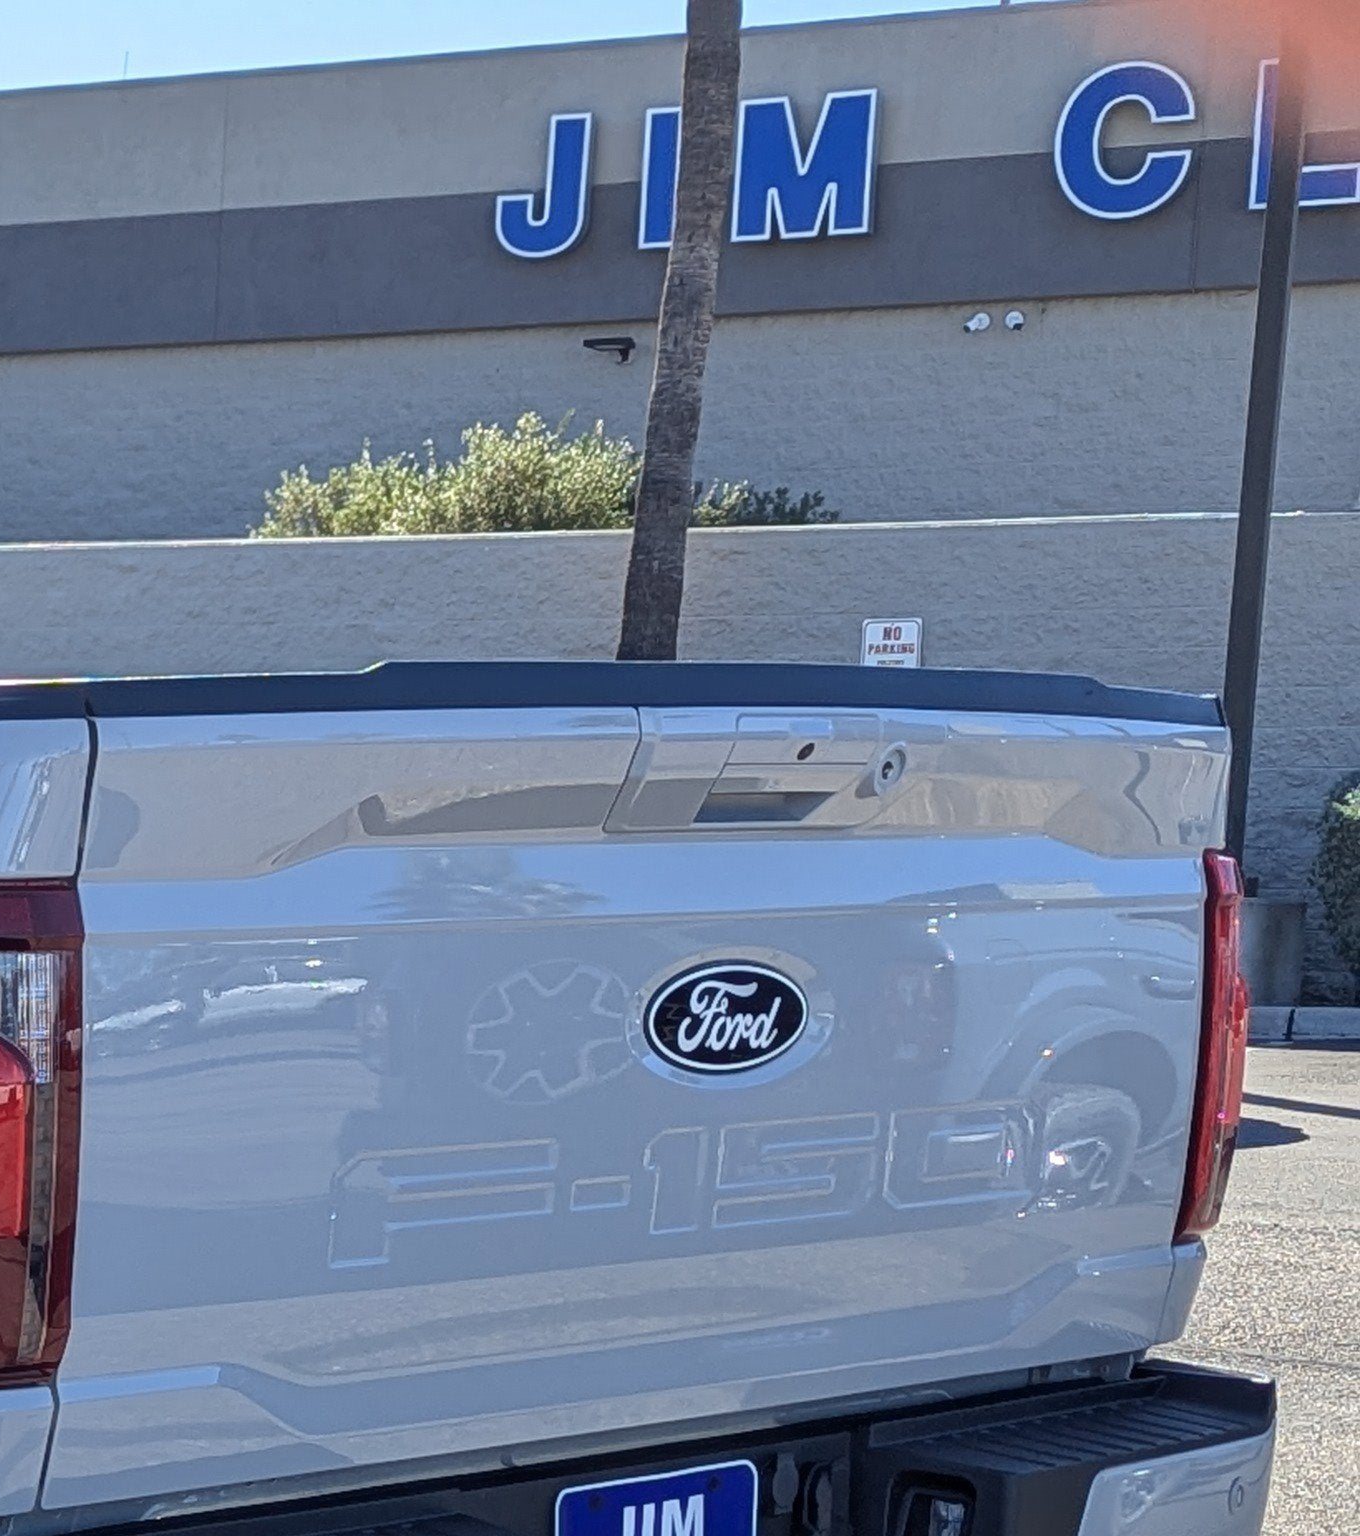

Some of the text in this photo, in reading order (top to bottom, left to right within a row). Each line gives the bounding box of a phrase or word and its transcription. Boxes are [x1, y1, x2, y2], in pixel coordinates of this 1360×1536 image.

[494, 88, 878, 259] JIM
[868, 643, 915, 655] PARKING
[882, 626, 902, 641] NO
[677, 979, 782, 1052] Ford
[329, 1099, 1038, 1269] F-150
